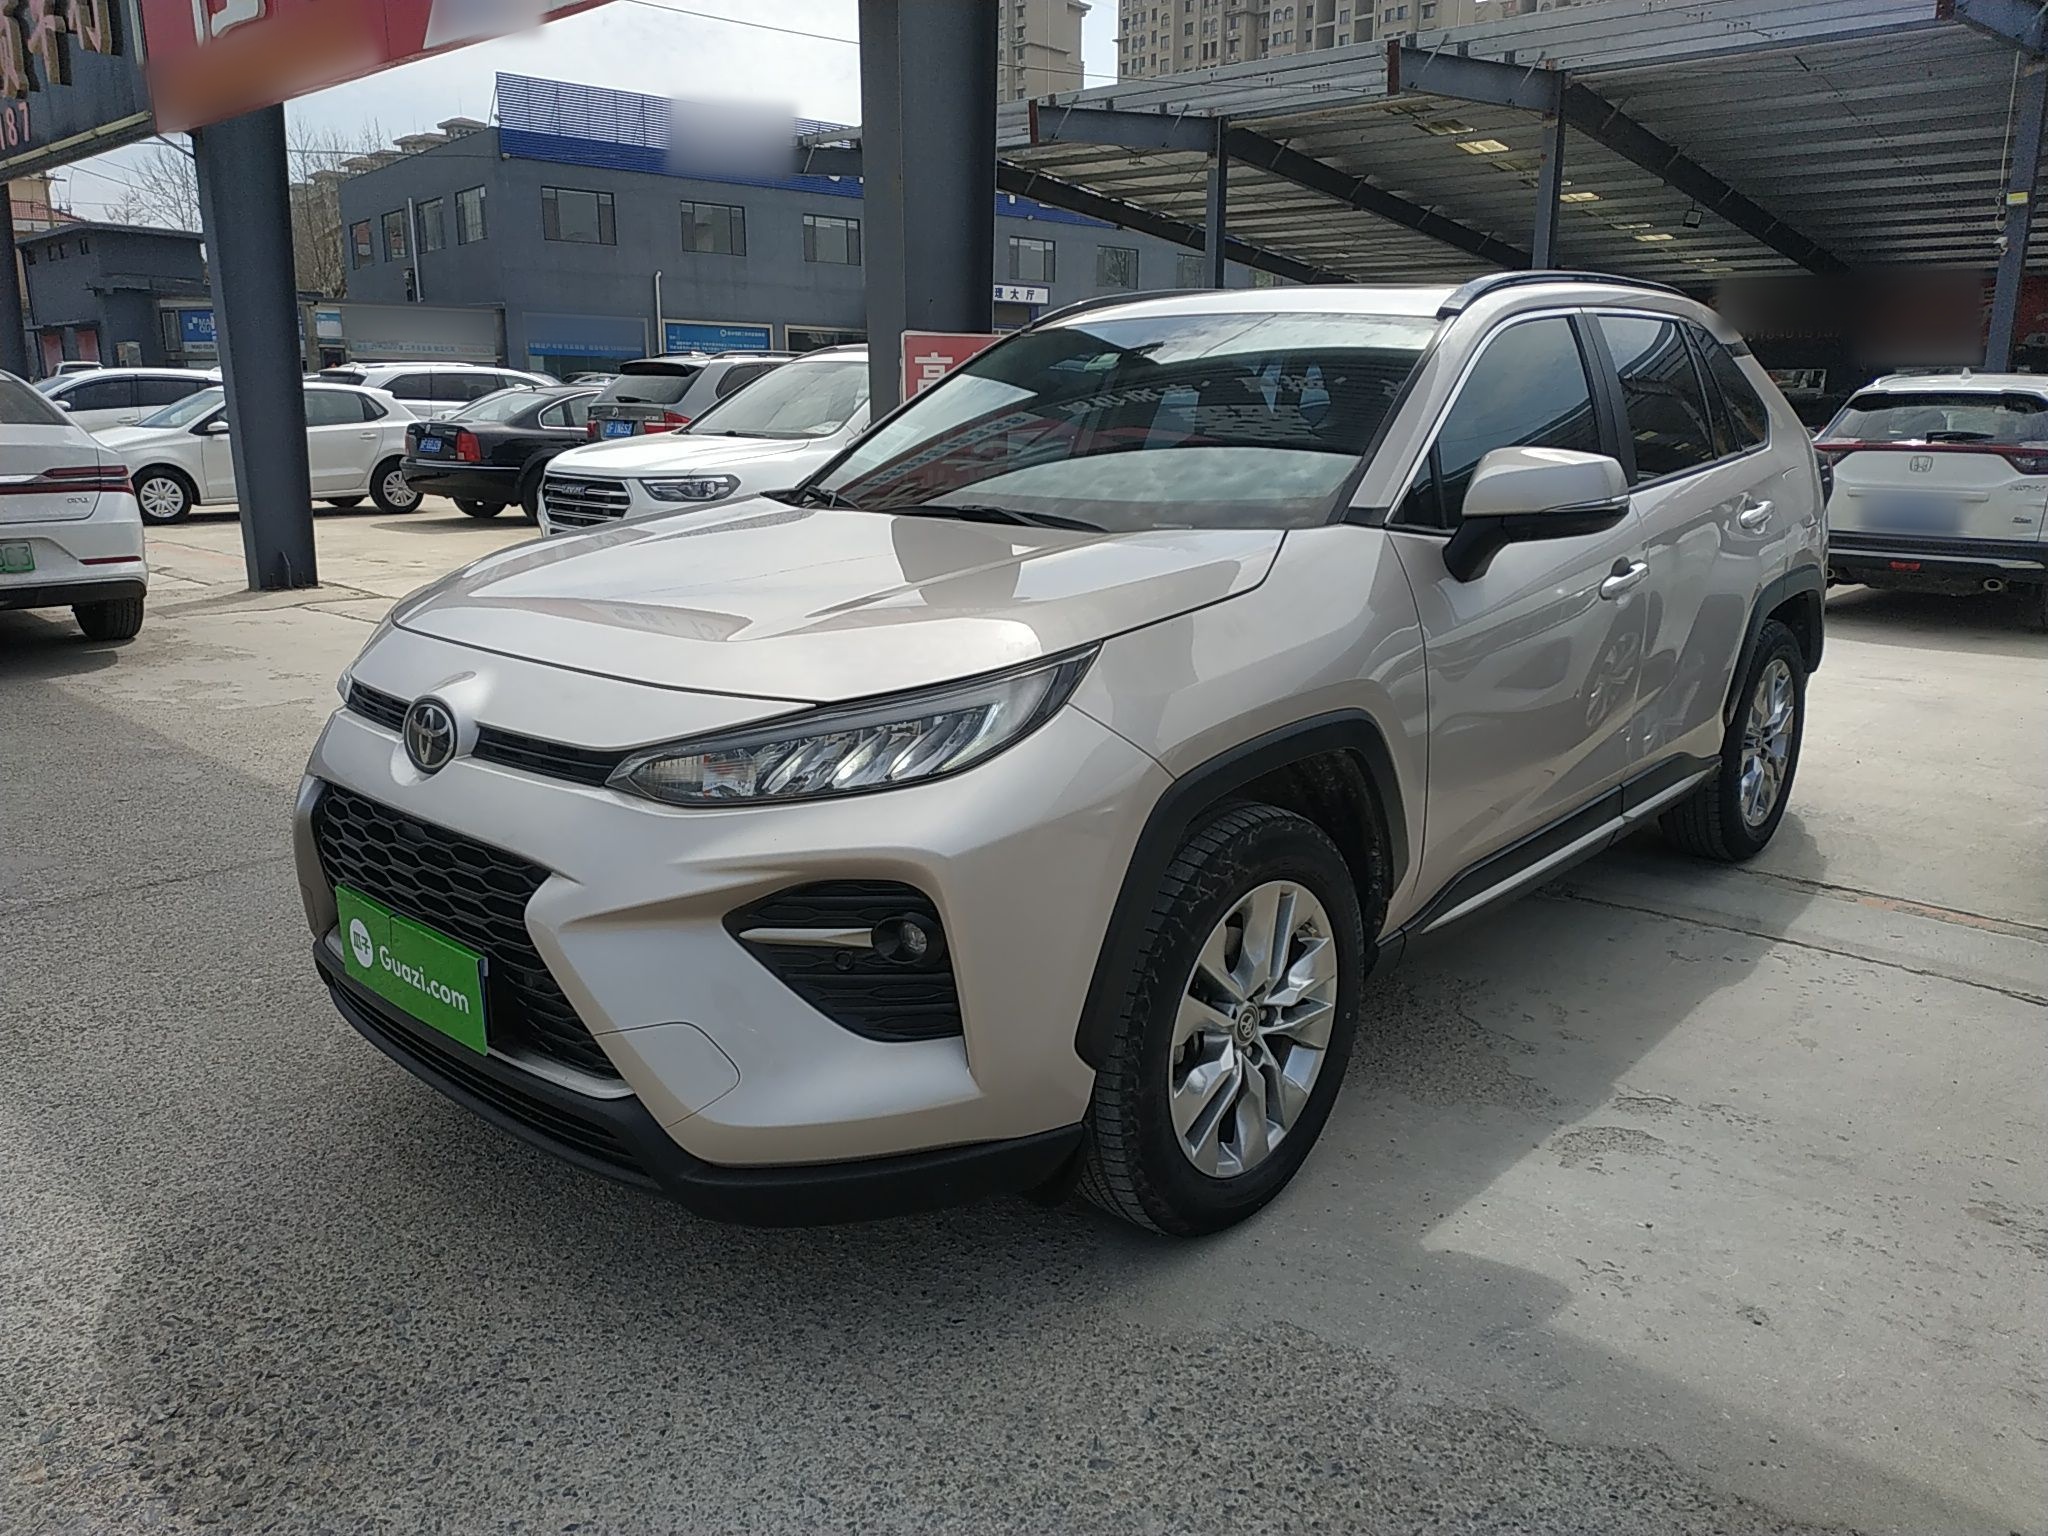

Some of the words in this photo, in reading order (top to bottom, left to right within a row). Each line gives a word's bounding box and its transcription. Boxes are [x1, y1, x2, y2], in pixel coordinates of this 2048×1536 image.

[995, 287, 1035, 300] 理大厅
[353, 931, 371, 955] 瓜子
[380, 945, 470, 1014] Guazi.com
